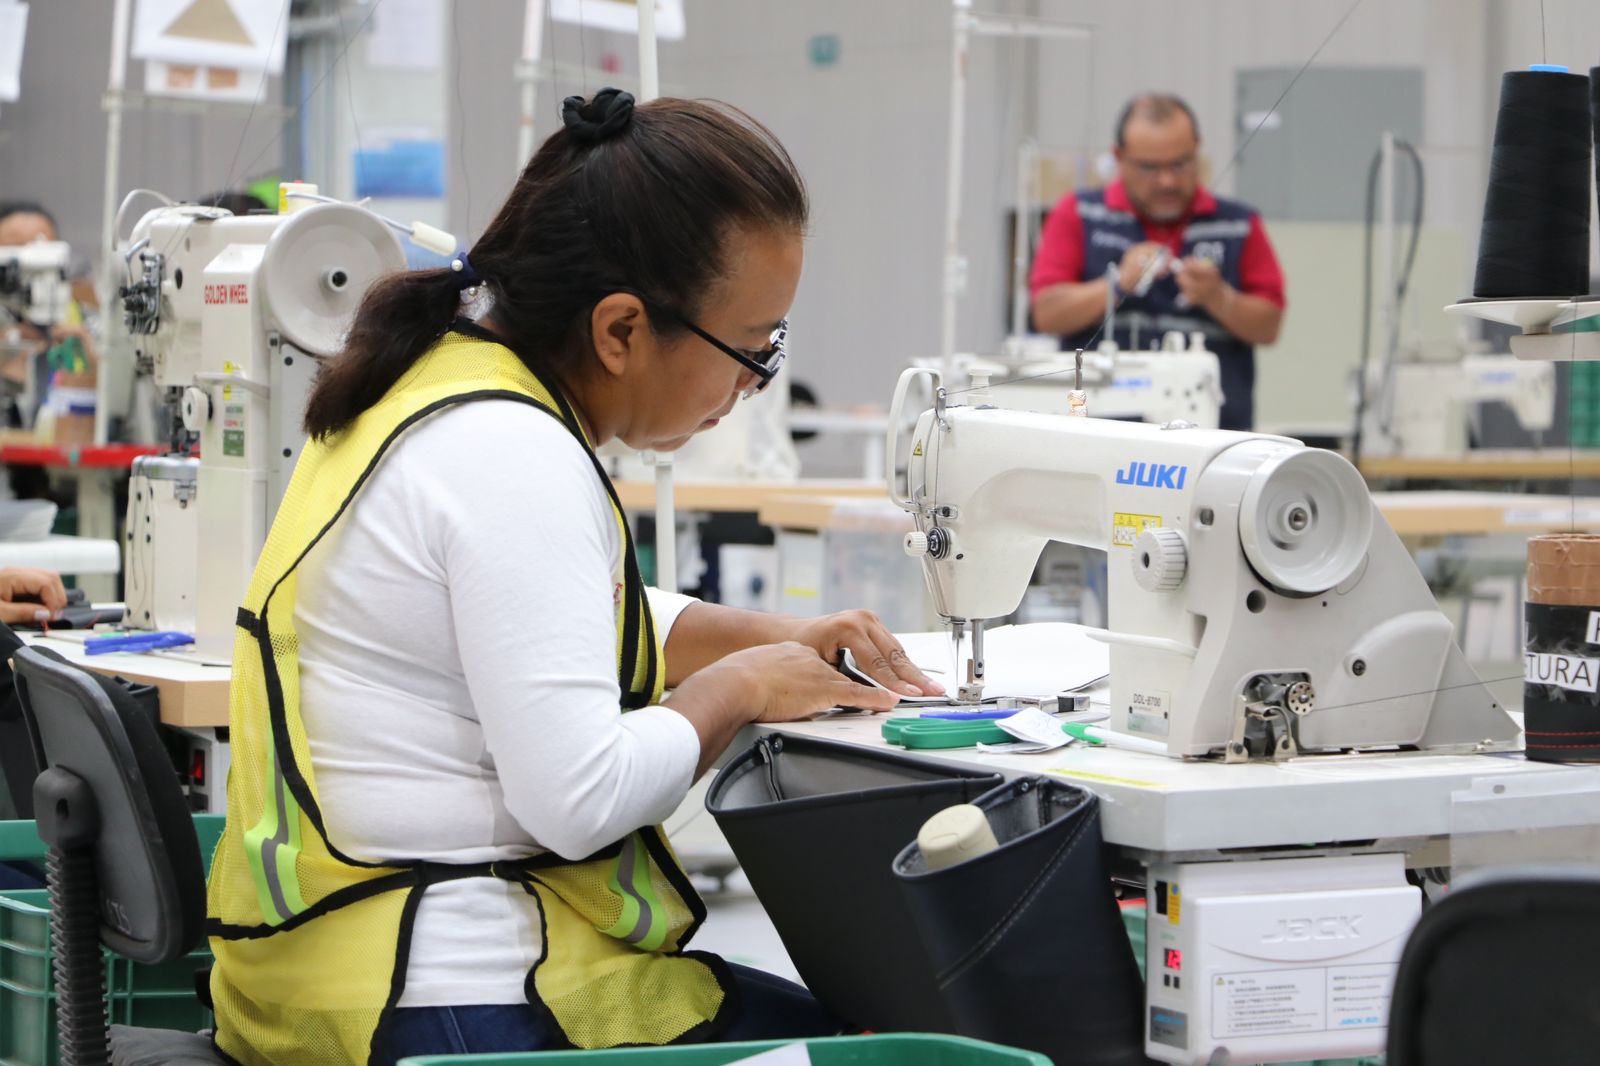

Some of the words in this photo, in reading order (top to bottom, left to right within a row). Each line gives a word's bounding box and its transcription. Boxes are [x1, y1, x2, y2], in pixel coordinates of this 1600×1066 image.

[204, 284, 227, 304] GOLDEN
[229, 284, 248, 304] WHEEL
[1115, 461, 1187, 490] JUKI
